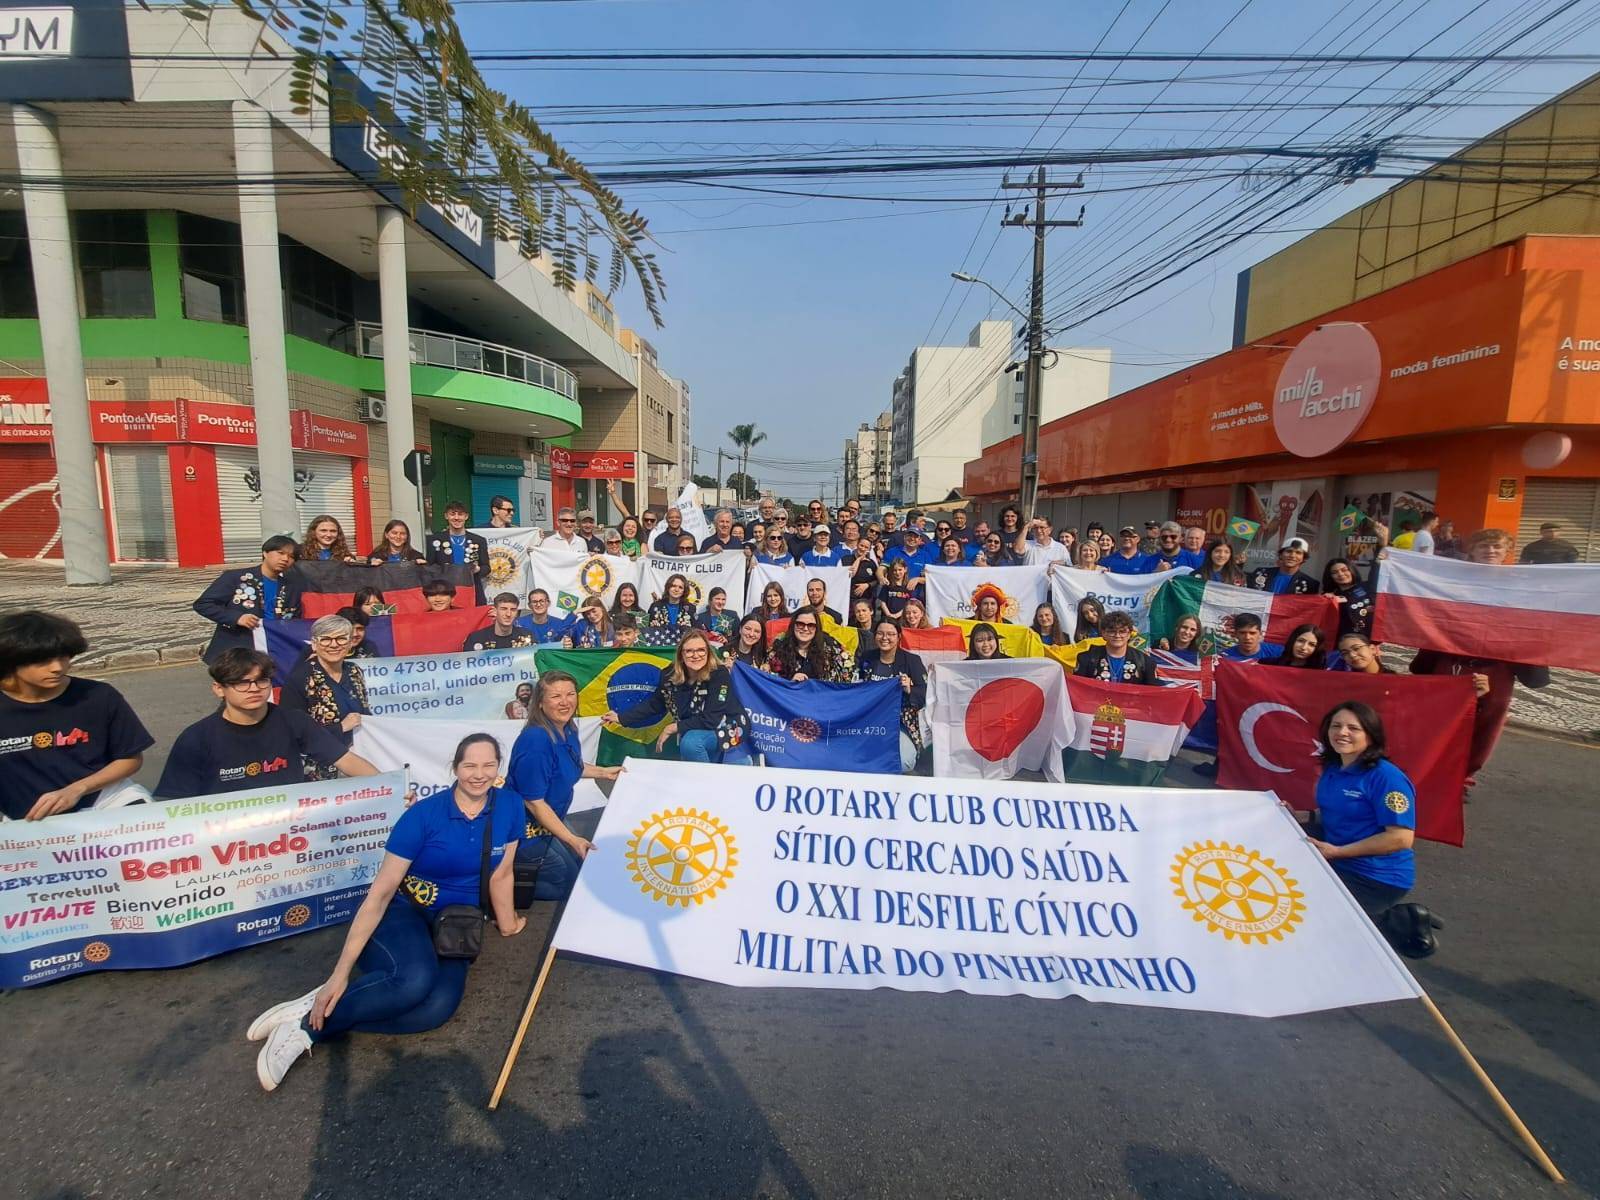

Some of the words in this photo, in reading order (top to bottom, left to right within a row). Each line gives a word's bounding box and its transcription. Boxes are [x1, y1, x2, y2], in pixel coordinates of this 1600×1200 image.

[1560, 336, 1573, 350] A
[1390, 361, 1428, 378] moda
[1431, 344, 1500, 369] feminina
[1558, 355, 1568, 370] é
[100, 412, 134, 424] Ponto
[134, 415, 145, 423] de
[144, 412, 177, 423] Visão
[124, 423, 156, 431] DIGITAL
[198, 413, 241, 427] Ponto
[241, 419, 255, 428] de
[12, 428, 39, 437] ÓTICAS
[228, 426, 255, 434] DIGIT
[313, 425, 333, 436] Ponto
[651, 559, 690, 573] ROTARY
[695, 563, 723, 574] CLUB
[362, 664, 389, 678] rito
[394, 660, 438, 675] 4730
[442, 658, 462, 671] de
[466, 654, 515, 669] Rotary
[368, 678, 441, 697] national,
[445, 673, 488, 689] unido
[491, 674, 515, 684] em
[520, 669, 538, 680] bu
[445, 694, 464, 707] da
[0, 735, 33, 746] otary
[863, 725, 887, 736] 4730
[165, 793, 287, 819] Välkommen
[297, 796, 328, 809] Hos
[755, 783, 776, 812] O
[784, 785, 901, 820] ROTARY
[908, 791, 986, 825] CLUB
[993, 796, 1140, 832] CURITIBA
[82, 820, 166, 844] pagdating
[290, 817, 342, 835] Selamat
[344, 811, 387, 826] Datang
[52, 833, 195, 864] Willkommen
[120, 853, 202, 883] Bem
[211, 832, 309, 867] Vindo
[296, 840, 386, 864] Bienvenue
[774, 825, 856, 867] SÍTIO
[864, 837, 1014, 880] CERCADO
[1021, 840, 1131, 883] SAÚDA
[175, 862, 273, 889] LAUKIAMAS
[236, 870, 280, 889] добро
[284, 858, 360, 878] пожаловать
[27, 882, 121, 904] Tervetullut
[107, 884, 226, 914] Bienvenido
[4, 900, 96, 930] VITAJTE
[156, 900, 235, 928] Welkom
[324, 904, 335, 912] de
[324, 909, 351, 922] jovens
[775, 879, 799, 914] O
[805, 881, 861, 922] XXI
[873, 888, 1009, 934] DESFILE
[1014, 890, 1138, 938] CÍVICO
[236, 914, 281, 933] Rotary
[258, 925, 281, 937] Brasil
[22, 968, 58, 982] Distrito
[59, 961, 84, 972] 4730
[30, 951, 82, 971] Rotary
[734, 928, 887, 975] MILITAR
[892, 946, 945, 978] DO
[952, 951, 1197, 994] PINHEIRINHO
